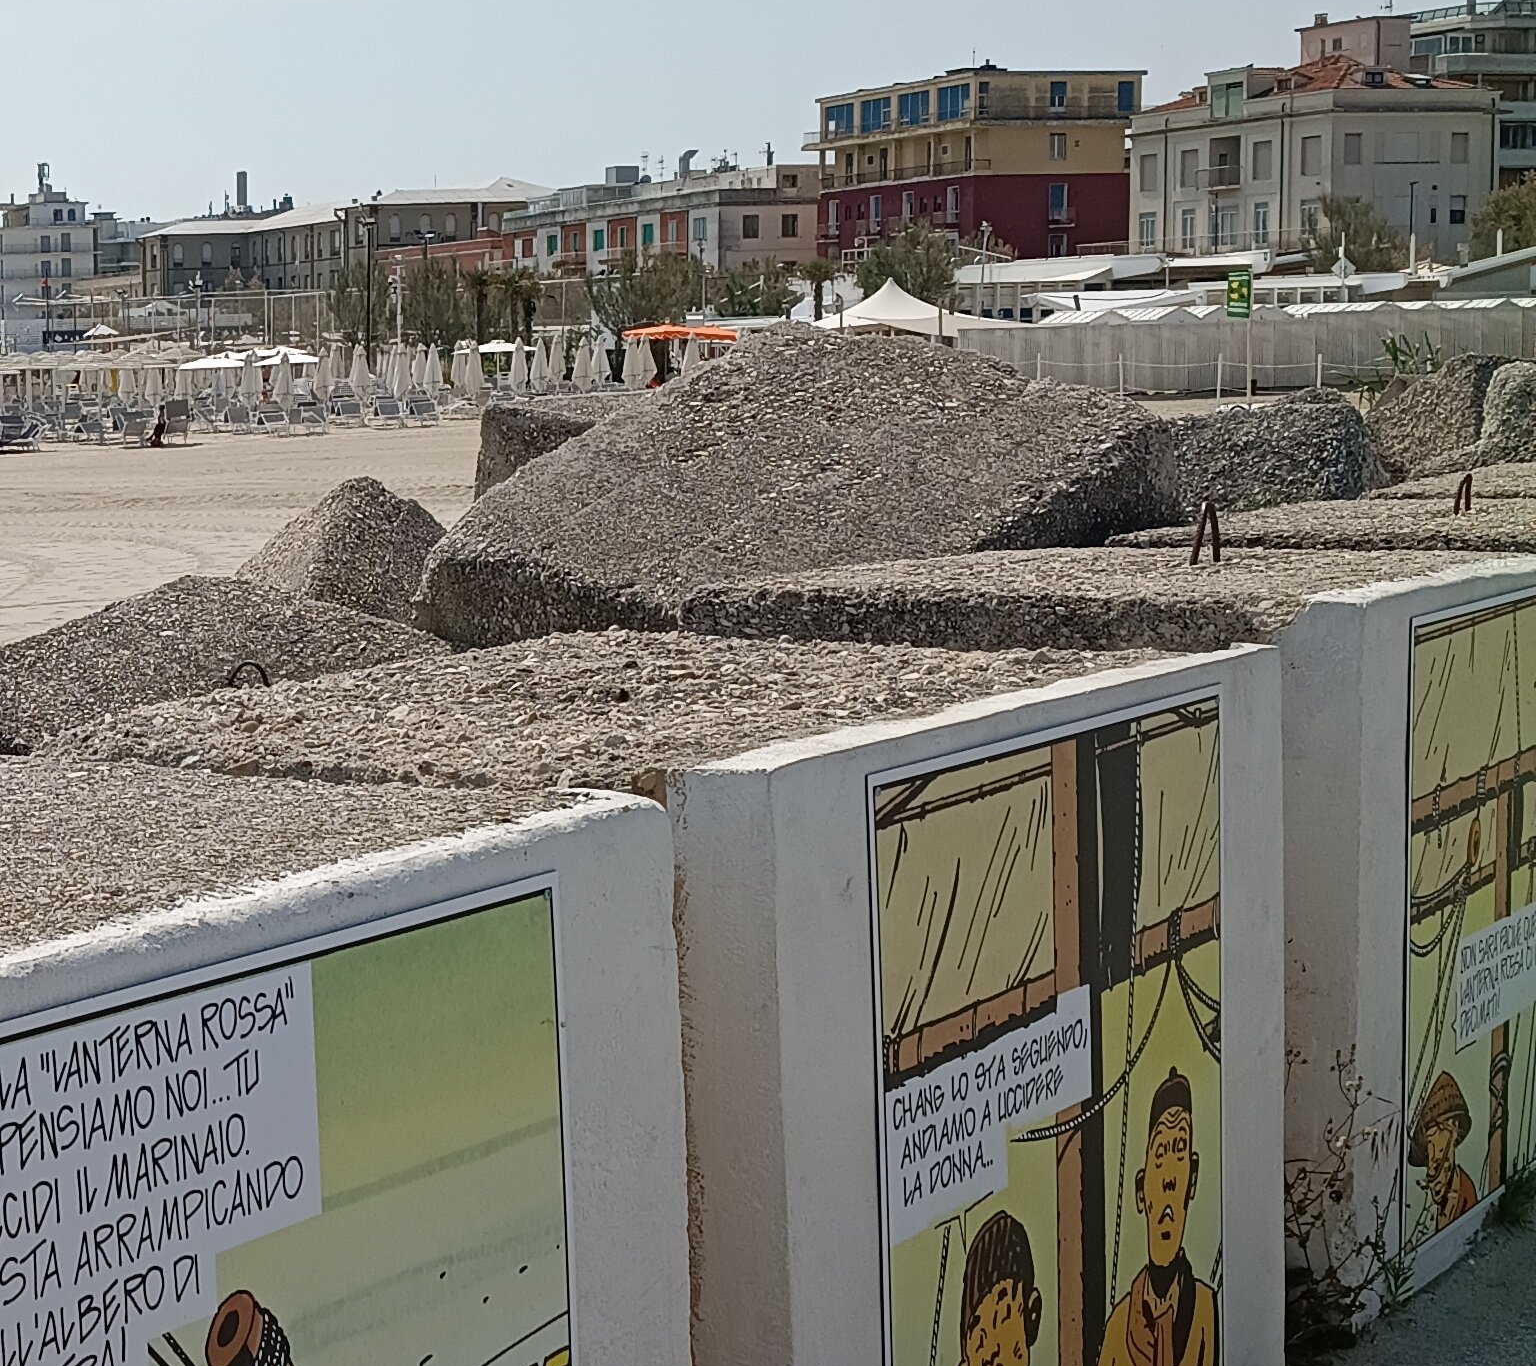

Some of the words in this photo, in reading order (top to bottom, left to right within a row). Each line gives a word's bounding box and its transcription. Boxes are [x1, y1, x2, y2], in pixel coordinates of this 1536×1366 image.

[40, 1013, 192, 1092] "LANTERNA
[201, 976, 294, 1051] ROSSA"
[893, 1084, 945, 1131] CHANG
[951, 1072, 969, 1102] LO
[974, 1054, 1006, 1092] STA
[1012, 1018, 1088, 1075] SEGUENDO,
[76, 1166, 98, 1214] IL
[104, 1113, 250, 1207] MARINAIO.
[900, 1107, 976, 1170] ANDIAMO
[980, 1099, 991, 1132] A
[998, 1064, 1064, 1123] UCCIDERE
[903, 1170, 923, 1208] LA
[929, 1140, 994, 1194] DONNA...
[0, 1238, 62, 1306] STA
[74, 1155, 304, 1285] ARRAMPICANDO
[173, 1253, 200, 1303] DI
